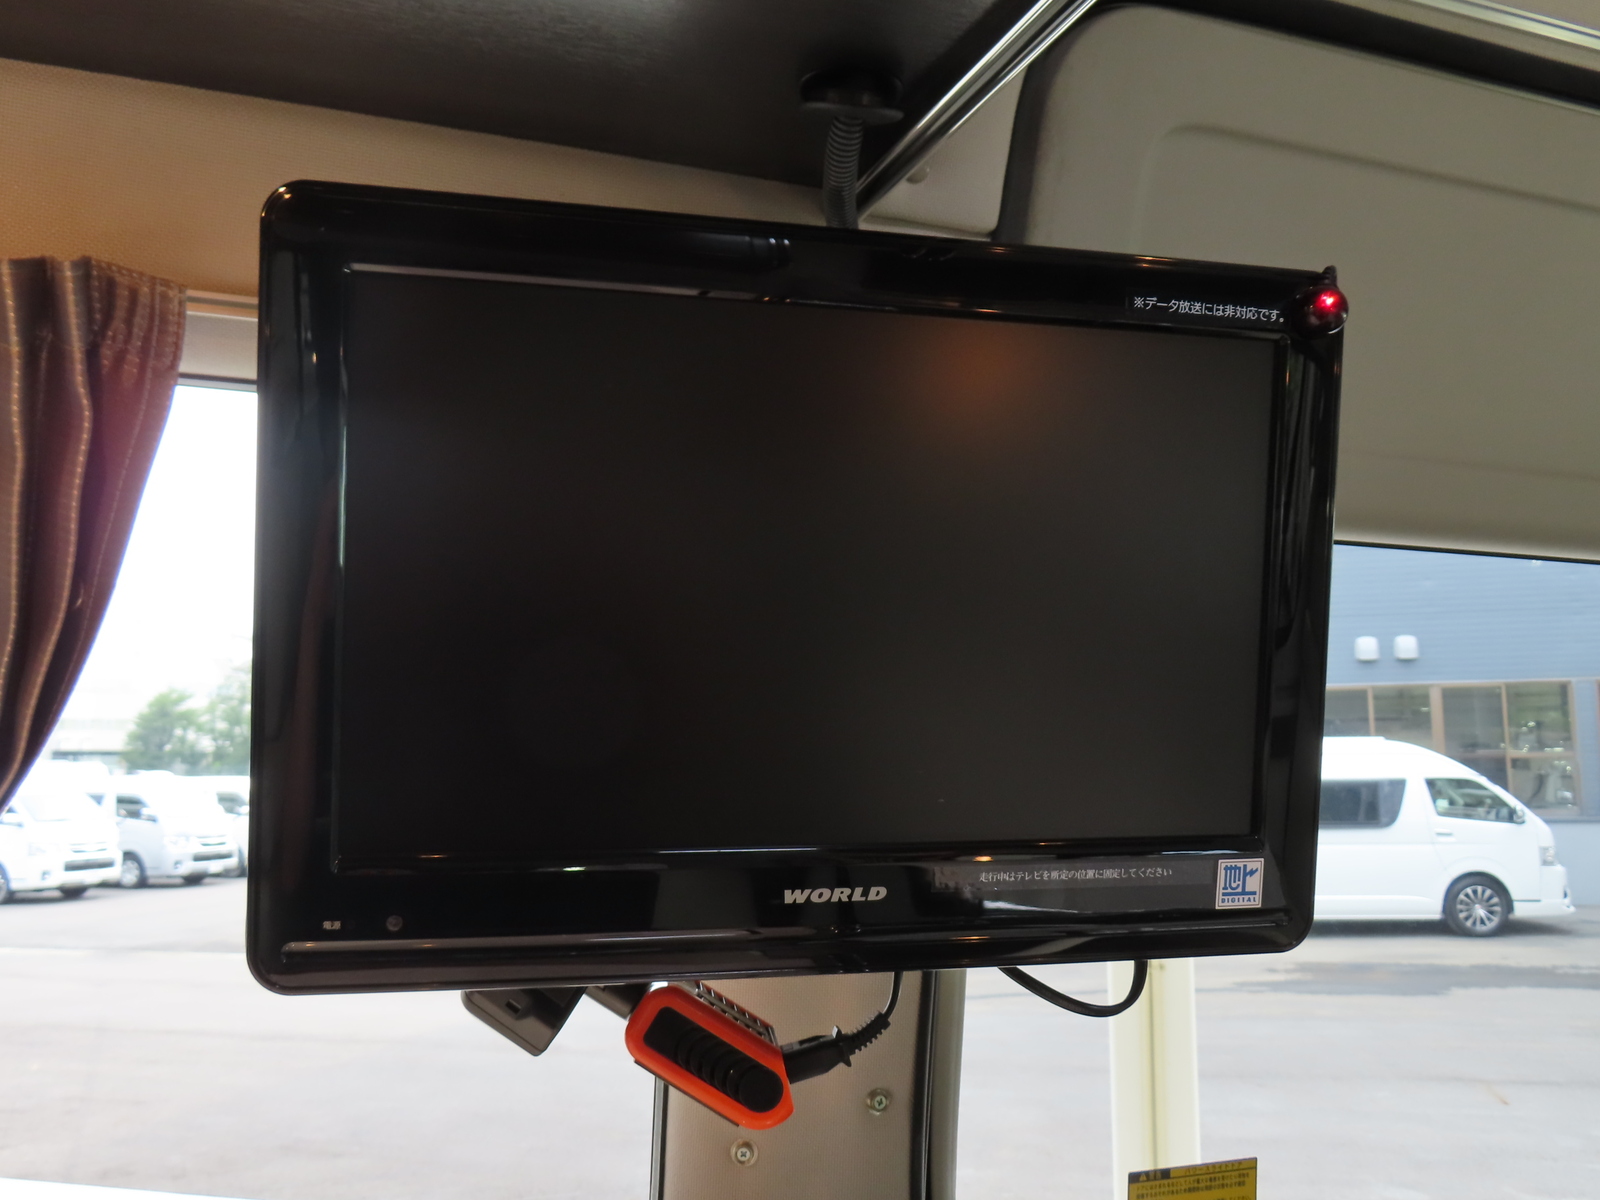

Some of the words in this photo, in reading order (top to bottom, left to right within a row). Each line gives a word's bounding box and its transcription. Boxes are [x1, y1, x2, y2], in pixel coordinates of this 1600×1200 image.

[1133, 296, 1285, 323] ※データ放送には非対応です。
[979, 867, 1173, 883] 走行中はテレビを所定の位置に固定してください
[784, 886, 888, 904] WORLD
[1220, 896, 1257, 904] DIGITAL
